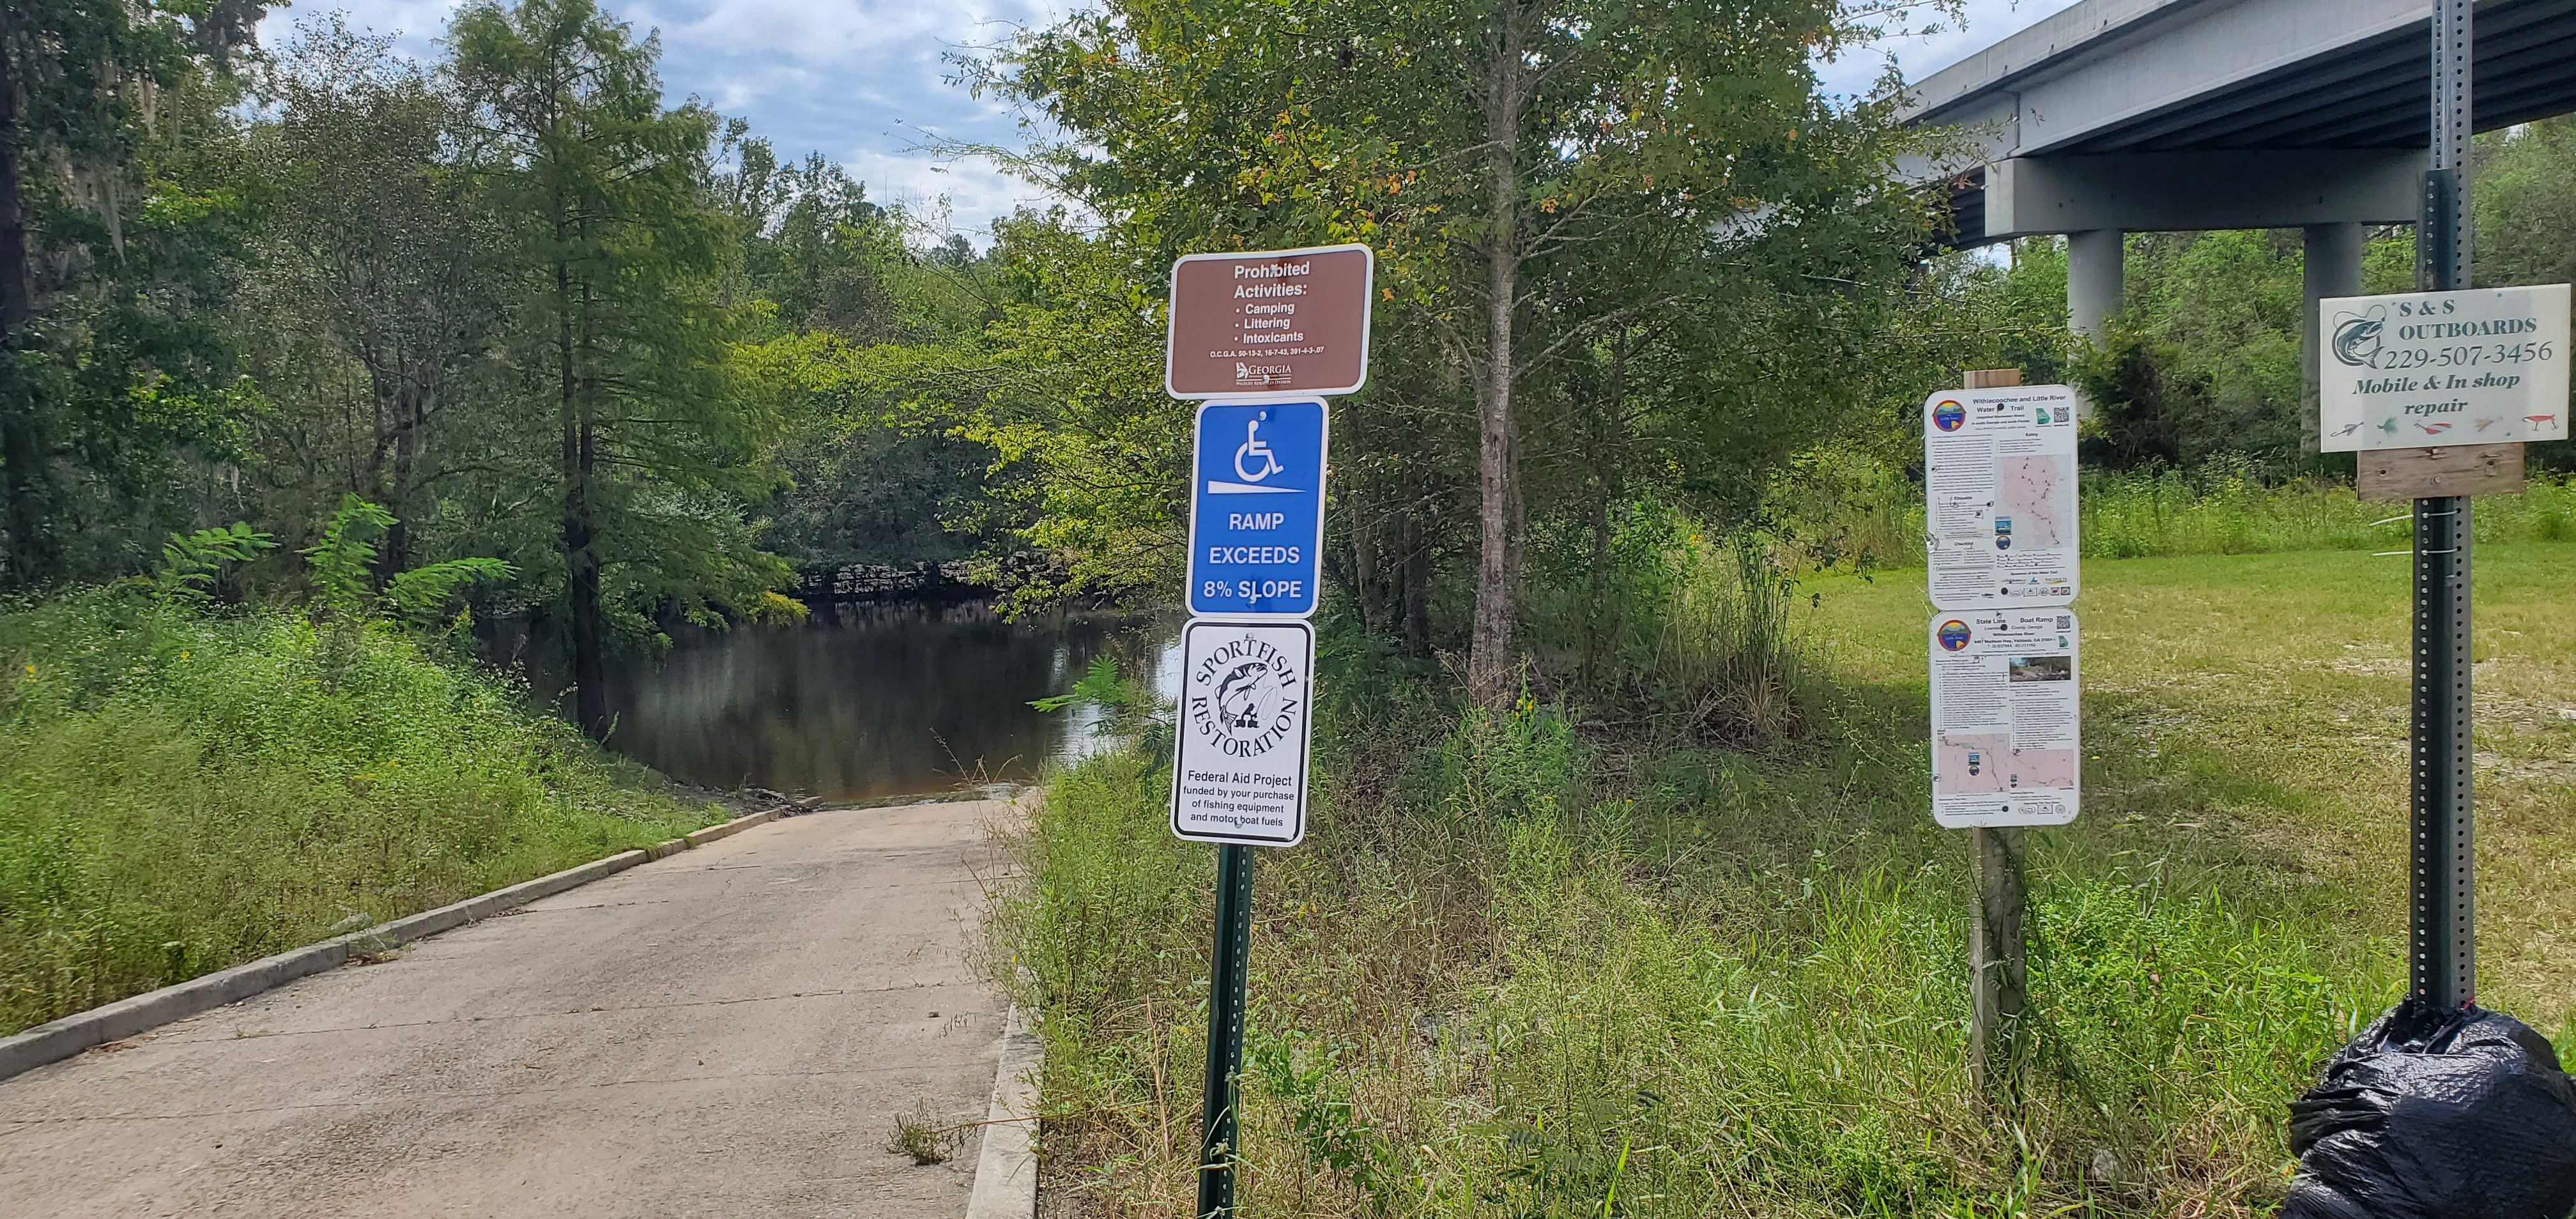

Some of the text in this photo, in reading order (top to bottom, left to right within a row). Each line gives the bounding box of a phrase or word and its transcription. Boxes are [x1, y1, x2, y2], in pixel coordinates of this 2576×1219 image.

[1234, 261, 1310, 279] Prohibited
[1234, 282, 1307, 298] Activities:
[1245, 302, 1295, 316] Camping
[2399, 299, 2455, 318] S & S
[1244, 317, 1291, 330] Littering
[2398, 318, 2537, 341] OUTBOARDS
[1243, 332, 1304, 344] Intoxicants
[2384, 341, 2553, 370] 229-507-3456
[1248, 364, 1292, 374] GEORGIA
[2352, 372, 2520, 395] Mobile & In shop
[2404, 398, 2468, 417] repair
[1229, 513, 1284, 530] RAMP
[1209, 547, 1300, 564] EXCEEDS
[1203, 580, 1302, 598] 8% SLOPE
[1196, 640, 1297, 690] SPORTFISH
[1192, 696, 1298, 758] RESTORATION
[1188, 770, 1292, 788] Federal Aid Project
[1183, 786, 1294, 801] funded by your purchase
[1192, 799, 1284, 813] of fishing equipment
[1191, 813, 1284, 826] and motor boat fuels
